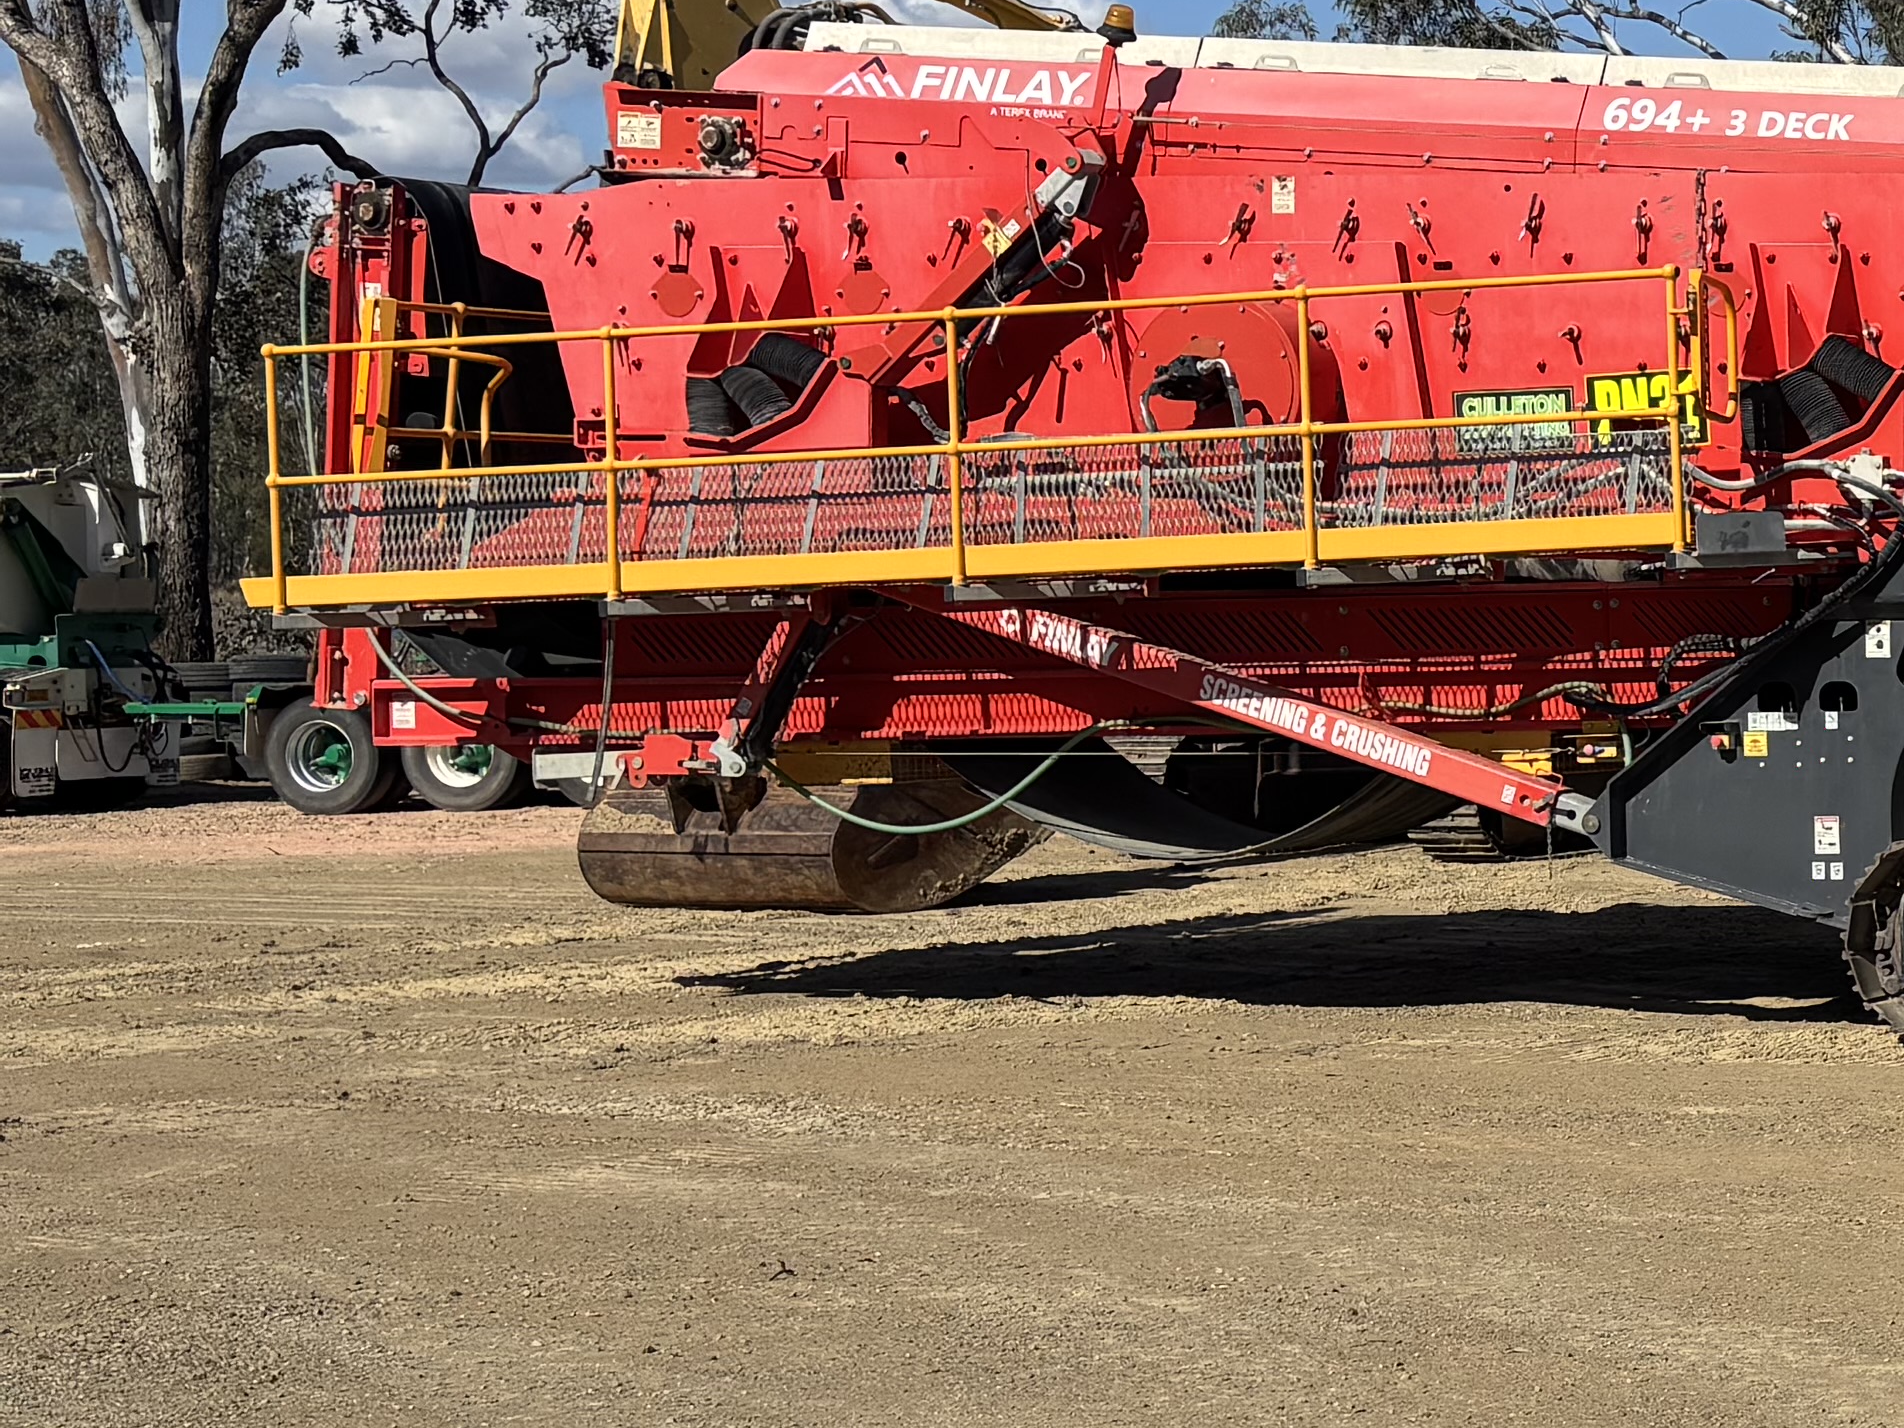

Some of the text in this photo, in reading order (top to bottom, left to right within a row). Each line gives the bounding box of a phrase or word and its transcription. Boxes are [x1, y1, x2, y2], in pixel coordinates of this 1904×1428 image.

[990, 106, 998, 117] A
[1602, 97, 1854, 140] 694+ 3 DECK
[1200, 673, 1432, 776] SCREENING & CRUSHING
